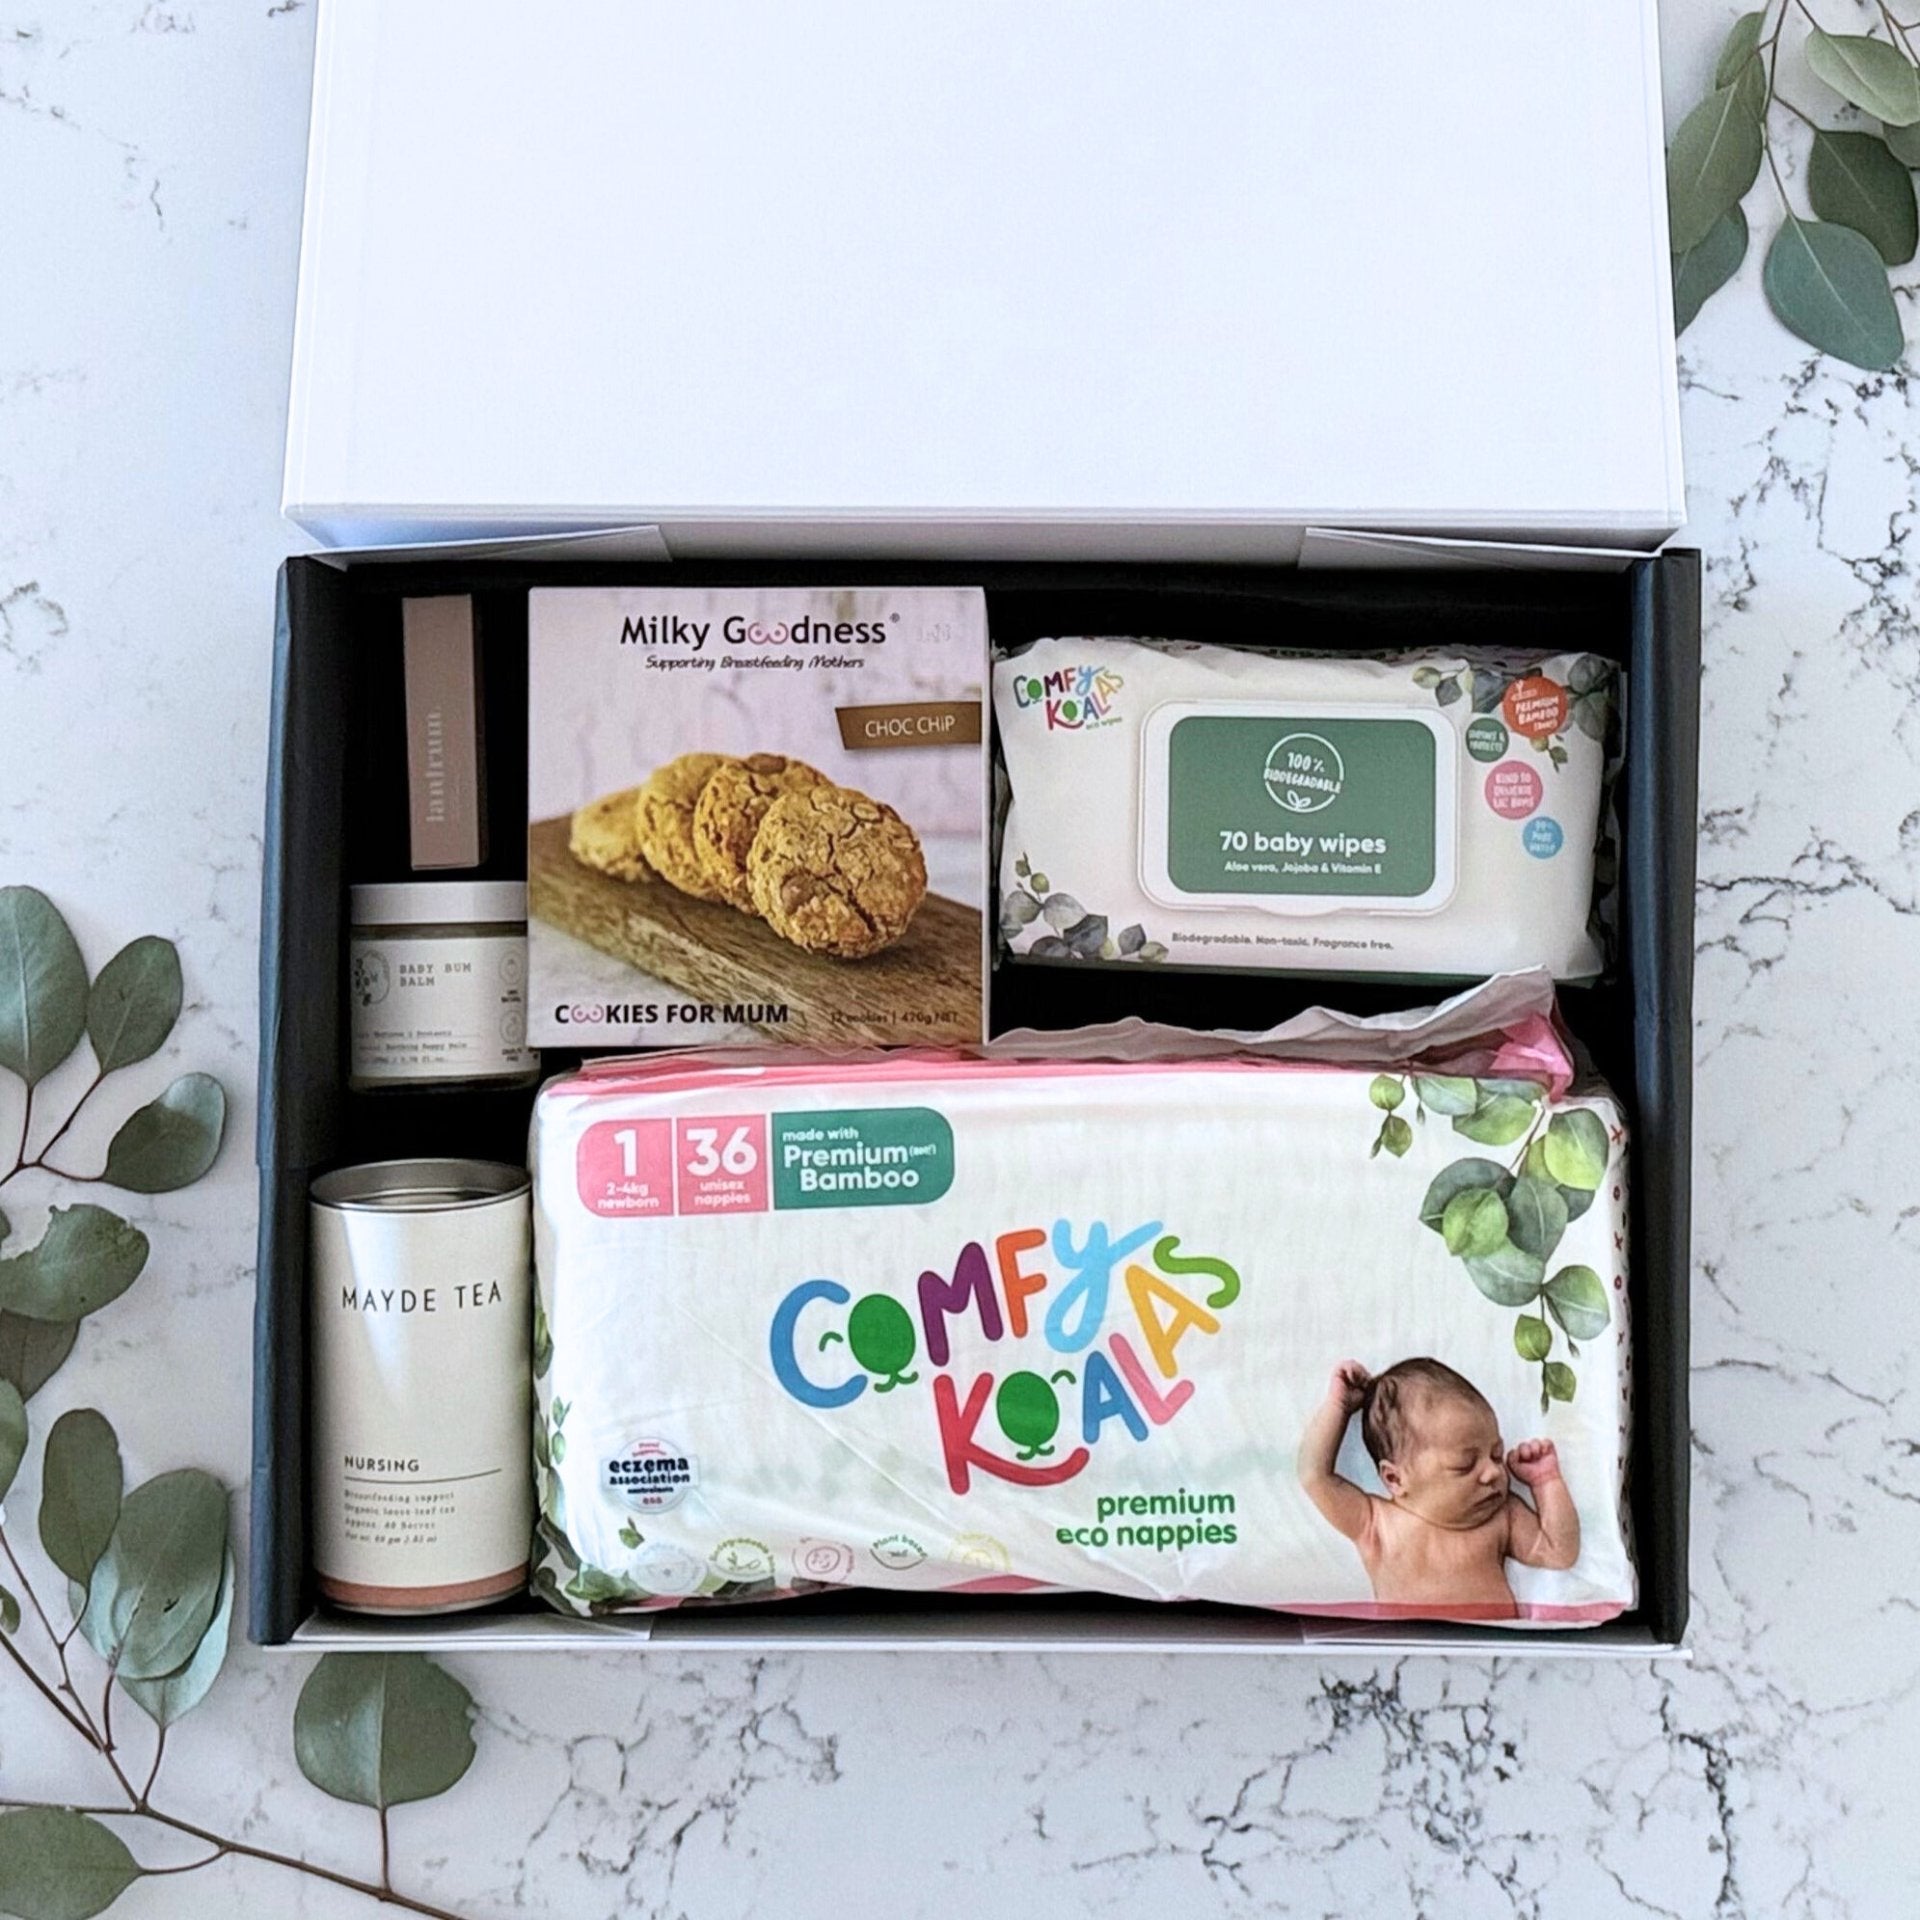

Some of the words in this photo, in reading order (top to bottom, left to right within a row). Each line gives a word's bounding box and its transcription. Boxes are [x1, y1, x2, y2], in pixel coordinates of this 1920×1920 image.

[620, 615, 711, 650] Milky
[645, 655, 715, 671] Supporting
[719, 655, 804, 671] Breastfeeding
[808, 655, 865, 669] Mothers
[1013, 664, 1105, 708] COMFY
[1046, 669, 1124, 730] KOALAS
[865, 717, 912, 738] CHOC
[1287, 752, 1325, 773] 100%
[1219, 830, 1248, 851] 70
[1254, 831, 1313, 857] baby
[1319, 833, 1387, 858] wipes
[1224, 861, 1249, 872] Aloe
[1281, 862, 1319, 875] Jojoba
[1320, 862, 1329, 873] &
[1330, 862, 1373, 874] Vitamin
[1374, 863, 1382, 874] E
[1313, 937, 1367, 949] Fragrance
[400, 963, 434, 974] BABY
[444, 962, 471, 973] BUM
[400, 976, 435, 987] BALM
[554, 1003, 659, 1024] COOKIES
[666, 1003, 717, 1023] FOR
[722, 1003, 789, 1022] MUM
[782, 1128, 824, 1142] made
[827, 1126, 859, 1139] with
[613, 1128, 637, 1177] 1
[686, 1126, 757, 1177] 36
[784, 1141, 908, 1168] Premium
[606, 1182, 649, 1196] 2-4kg
[700, 1179, 745, 1191] unisex
[800, 1166, 920, 1191] Bamboo
[598, 1196, 660, 1209] newborn
[694, 1193, 752, 1207] nappies
[342, 1286, 436, 1313] MAYDE
[454, 1280, 502, 1309] TEA
[769, 1217, 1163, 1409] COMFY
[933, 1234, 1241, 1495] KOALAS
[344, 1456, 420, 1472] NURSING
[609, 1457, 690, 1473] eczema
[609, 1473, 690, 1485] association
[1097, 1487, 1236, 1523] premium
[1056, 1526, 1109, 1547] eco
[1117, 1517, 1237, 1552] nappies
